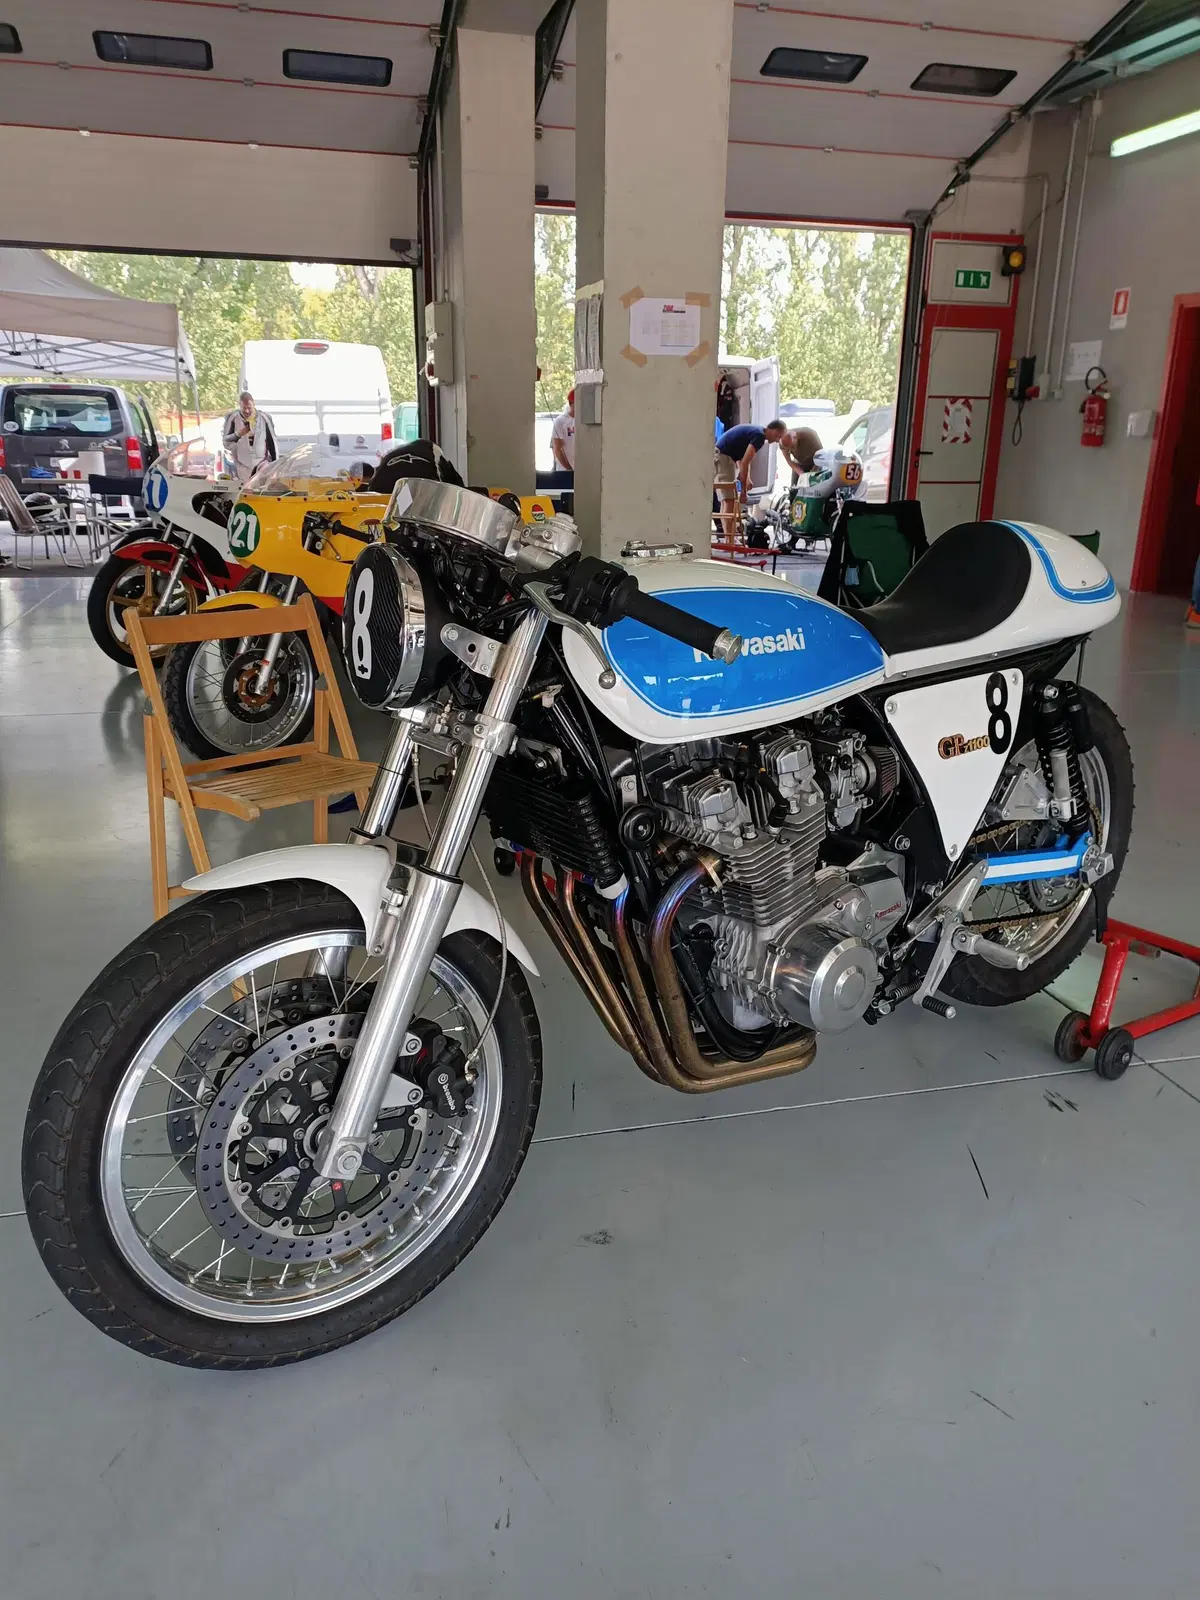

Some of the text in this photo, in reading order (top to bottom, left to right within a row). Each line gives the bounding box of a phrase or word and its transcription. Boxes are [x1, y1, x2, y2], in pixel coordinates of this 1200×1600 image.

[846, 464, 860, 480] 56
[352, 567, 374, 680] 8
[693, 627, 806, 663] asaki
[985, 671, 1012, 755] 8
[874, 900, 902, 919] Kawasaki
[443, 1083, 456, 1110] brembo
